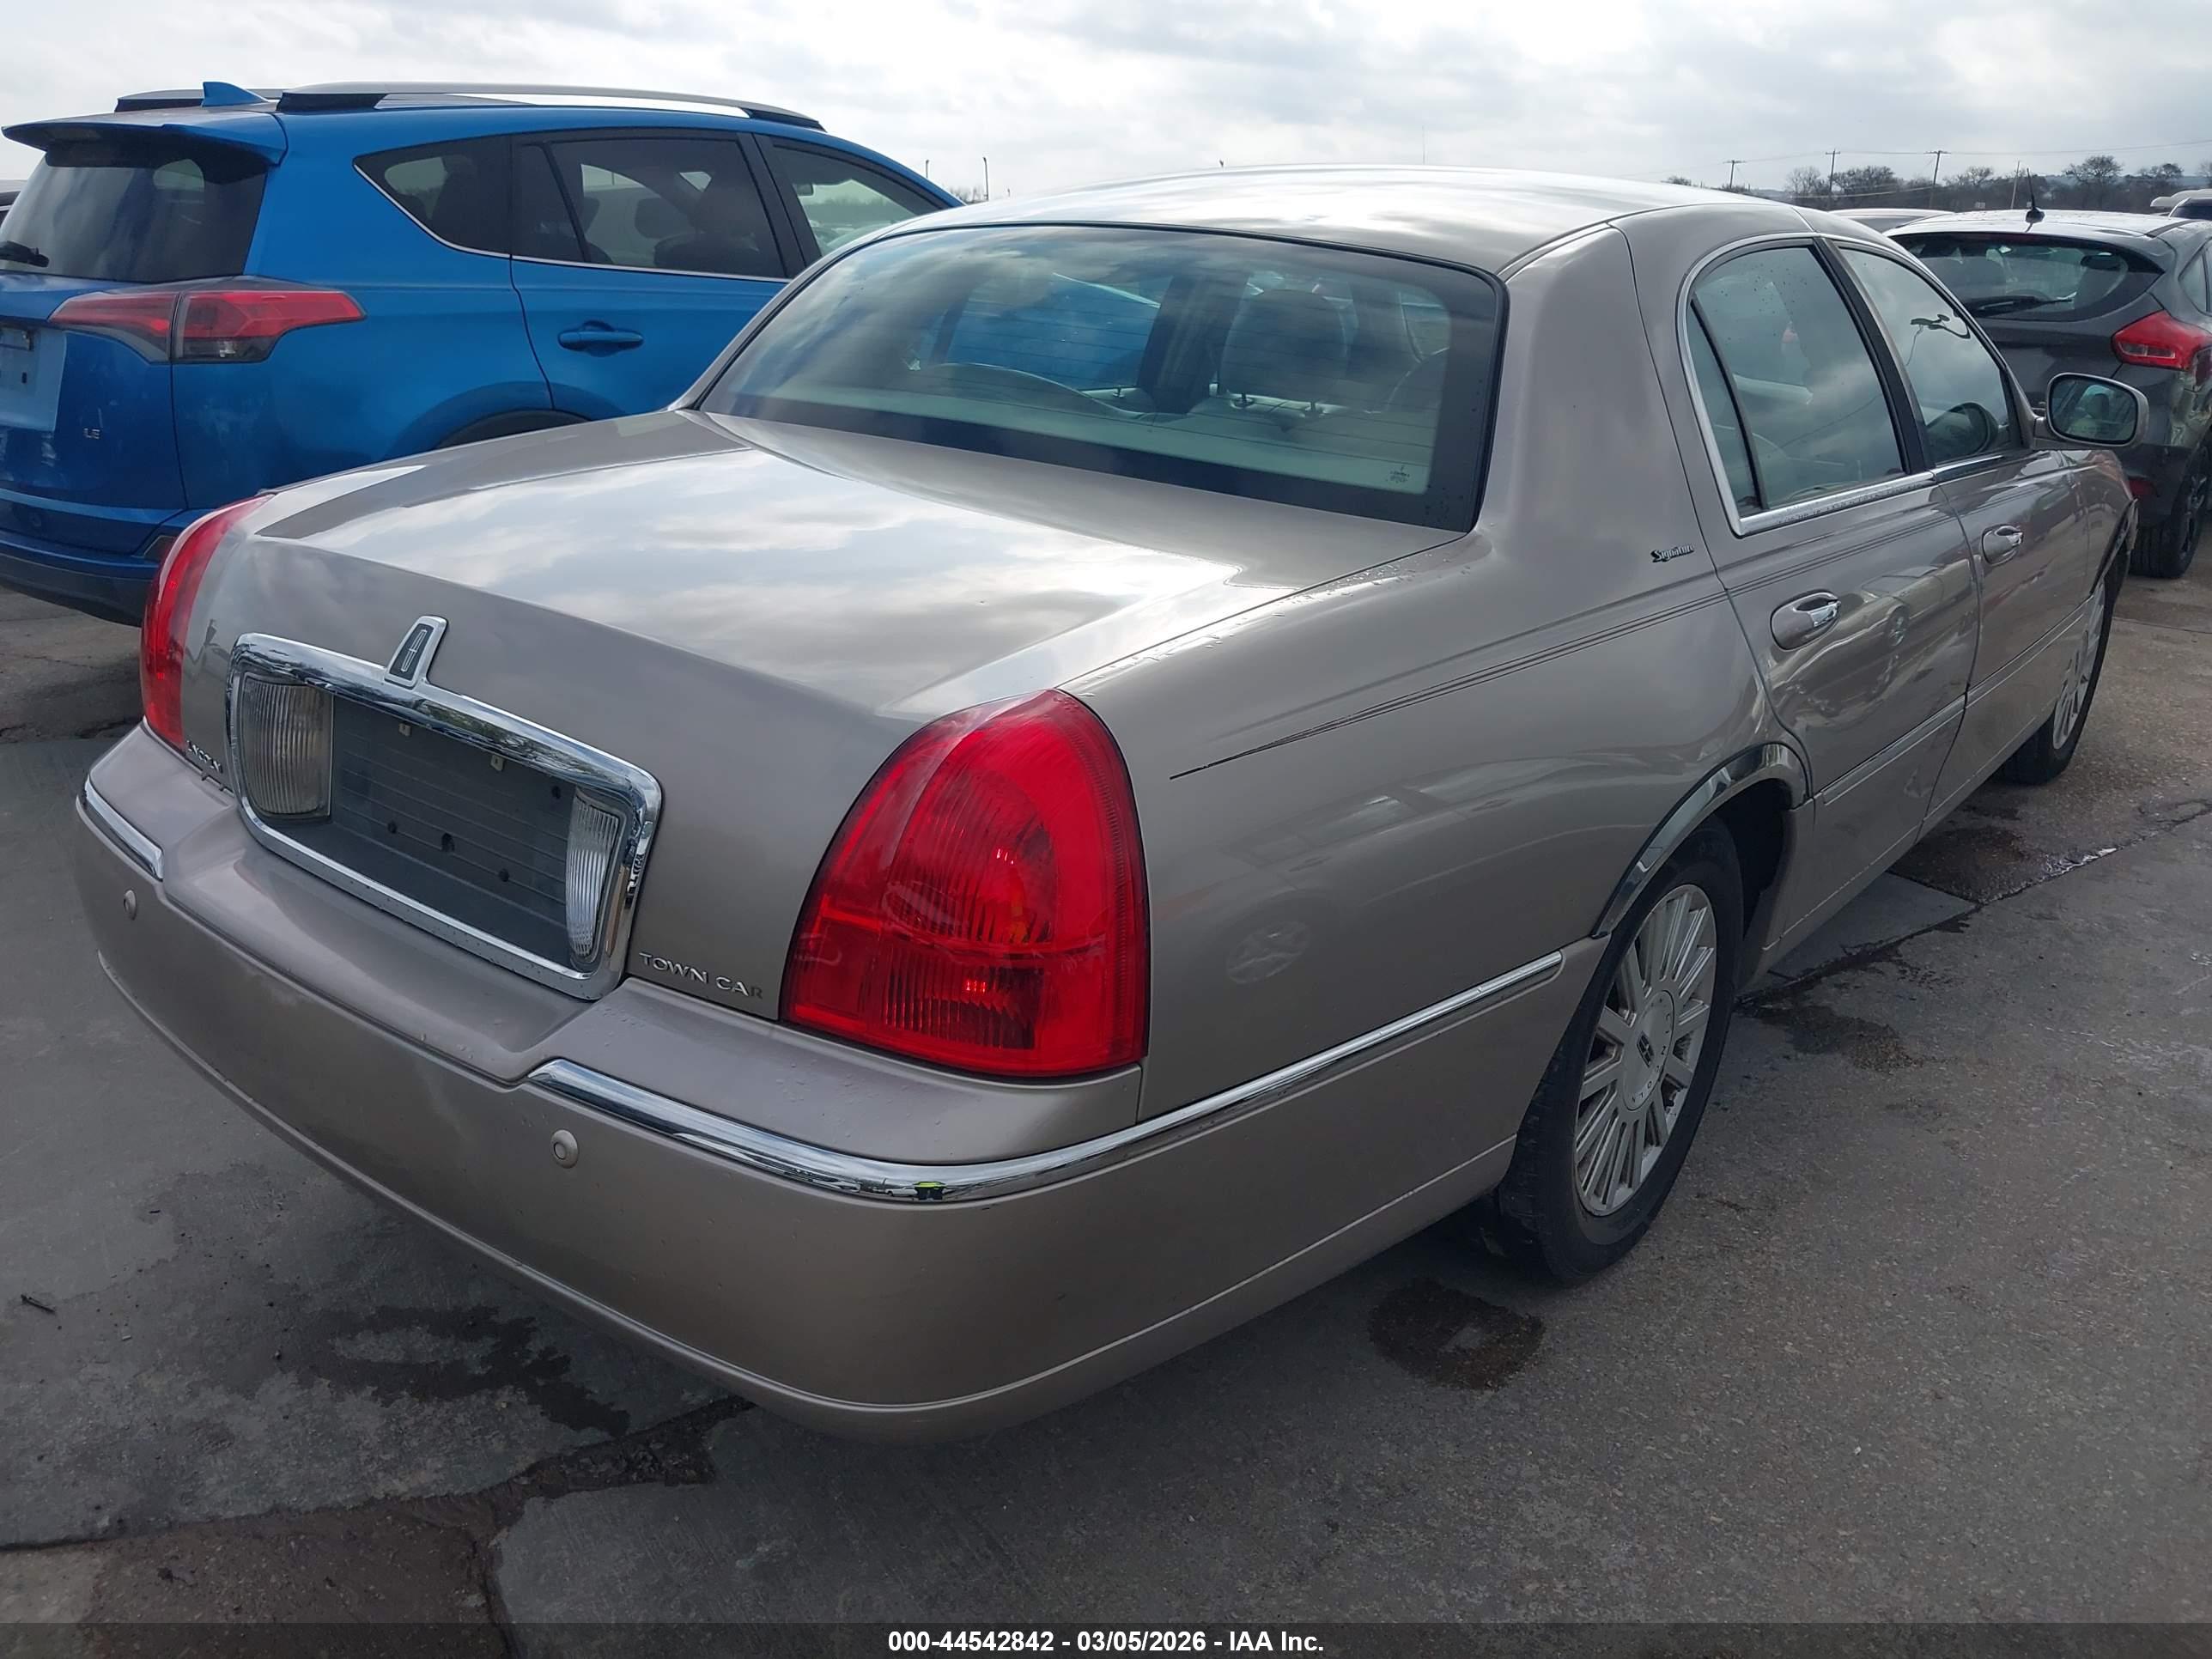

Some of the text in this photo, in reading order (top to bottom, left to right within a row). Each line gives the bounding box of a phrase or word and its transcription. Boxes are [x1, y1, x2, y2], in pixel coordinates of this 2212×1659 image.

[1650, 543, 1695, 562] Signature
[639, 951, 763, 1000] TOWN CAR
